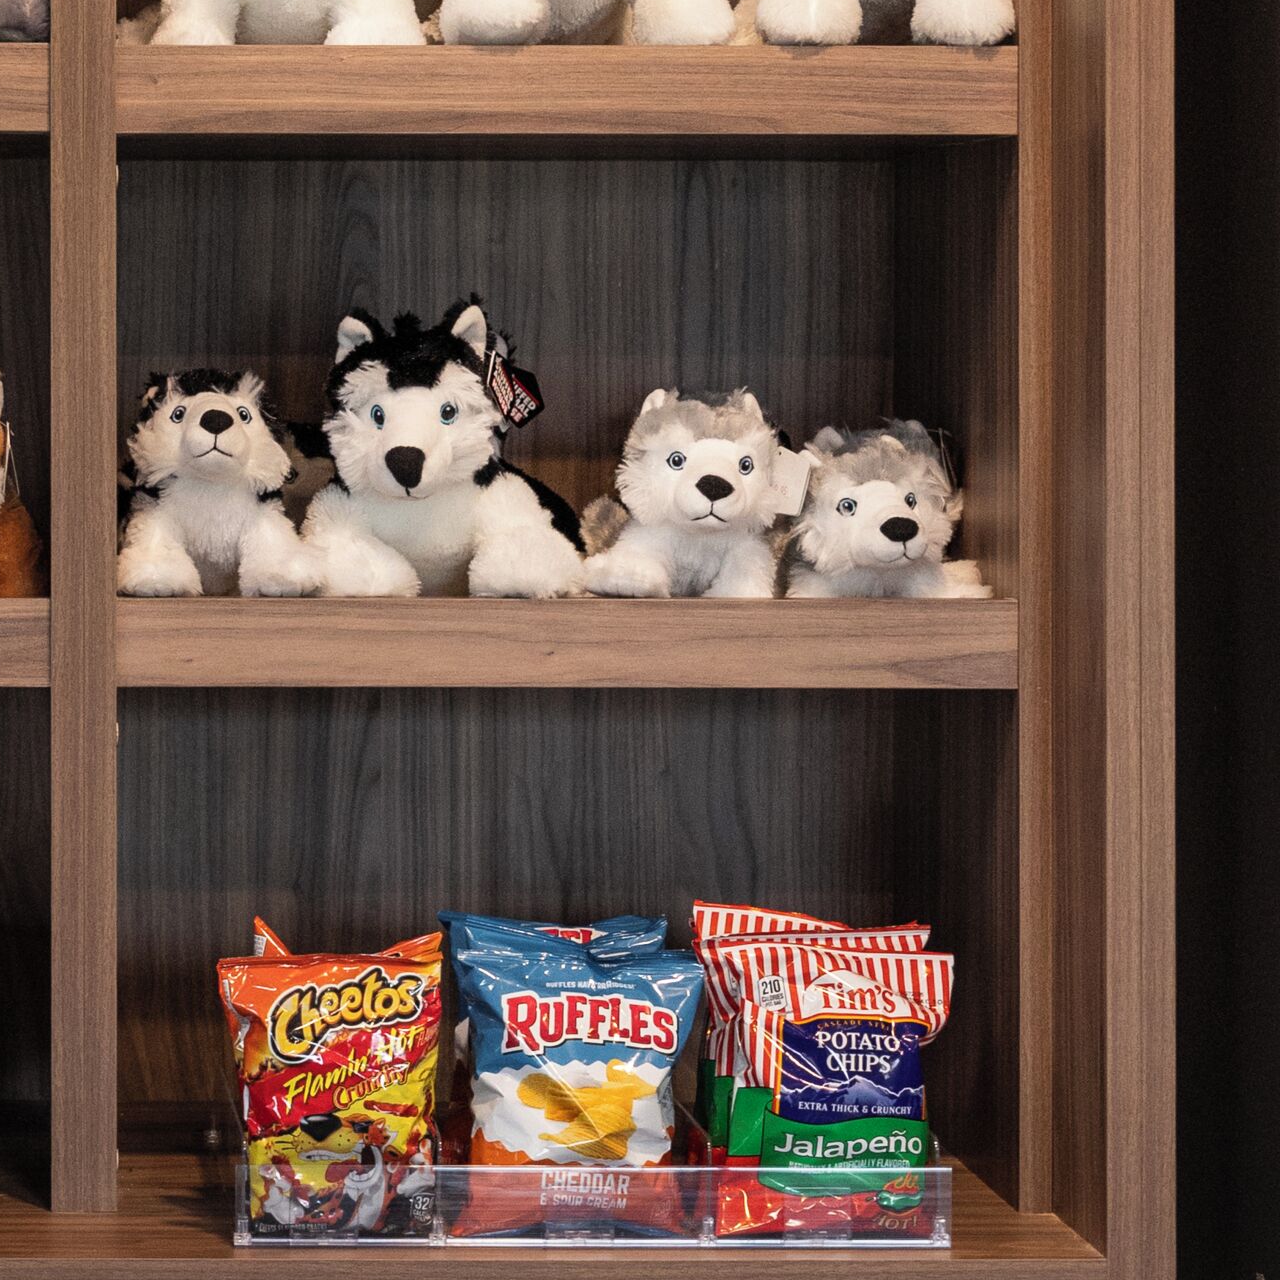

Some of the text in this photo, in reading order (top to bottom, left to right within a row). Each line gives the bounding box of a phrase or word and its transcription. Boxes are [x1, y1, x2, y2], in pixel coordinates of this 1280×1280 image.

[761, 979, 781, 995] 210
[815, 982, 897, 1013] Tim's
[273, 969, 420, 1057] Cheetos
[503, 992, 676, 1053] RUFFLES
[815, 1030, 900, 1053] POTATO
[826, 1052, 891, 1073] CHIPS
[798, 1101, 913, 1115] EXTRA THICK & CRUNCHY
[774, 1130, 922, 1159] Jalapeño
[876, 1158, 911, 1168] FLAVORED
[541, 1170, 630, 1195] CHEDDAR
[552, 1193, 583, 1206] SOUR
[586, 1196, 627, 1209] CREAM
